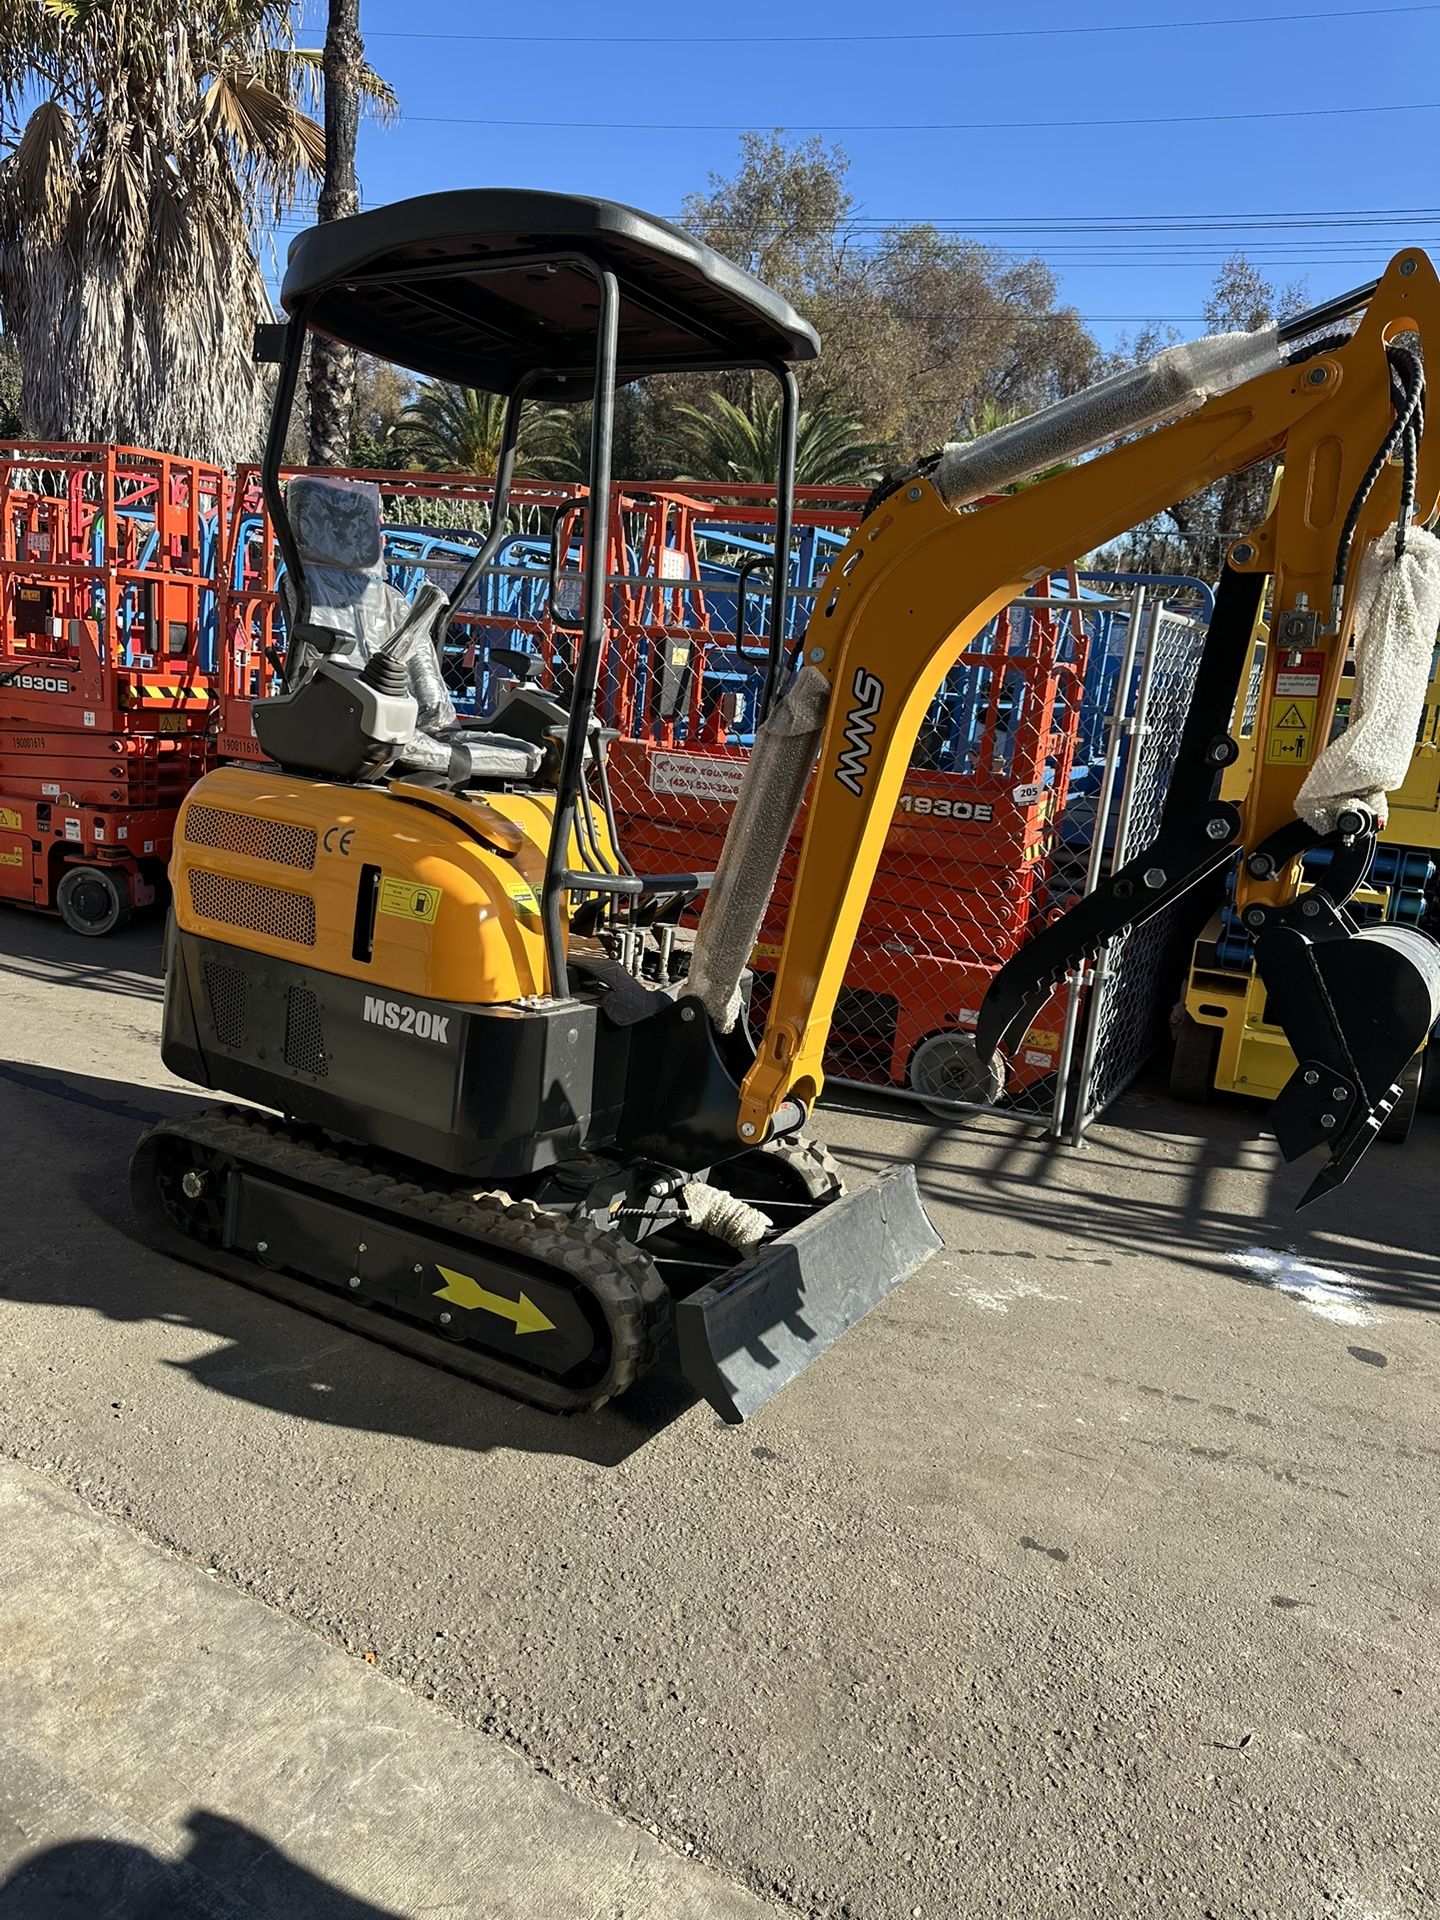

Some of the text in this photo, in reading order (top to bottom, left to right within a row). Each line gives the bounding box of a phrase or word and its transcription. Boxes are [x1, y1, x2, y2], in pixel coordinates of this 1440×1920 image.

[1020, 787, 1038, 797] 205
[323, 826, 356, 856] CE
[363, 995, 450, 1044] MS20K
